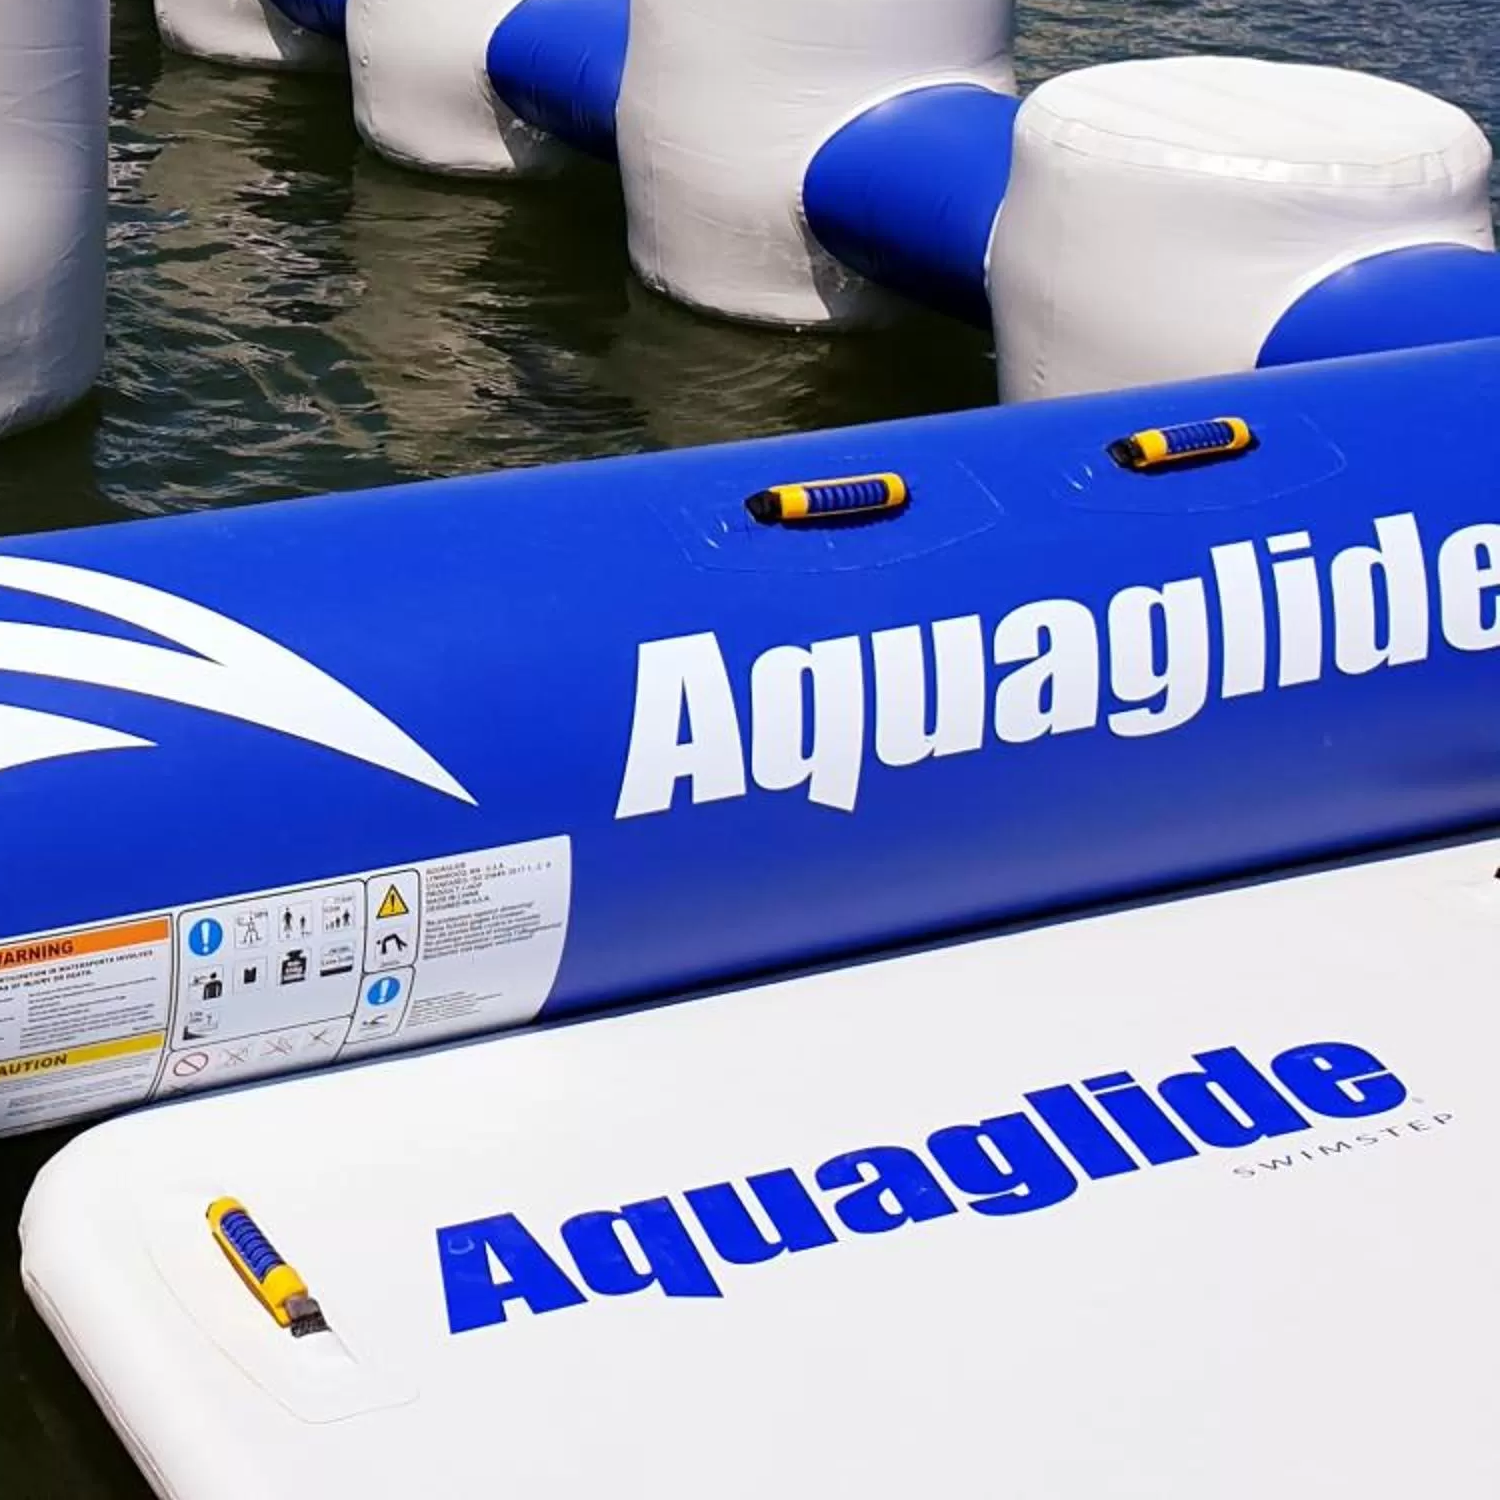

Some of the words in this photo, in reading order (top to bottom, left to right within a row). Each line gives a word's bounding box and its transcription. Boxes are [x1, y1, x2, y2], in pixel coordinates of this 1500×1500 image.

[615, 511, 1500, 819] Aquaglide
[437, 1041, 1409, 1334] Aquaglide
[1233, 1111, 1453, 1178] SWIMSTEP
